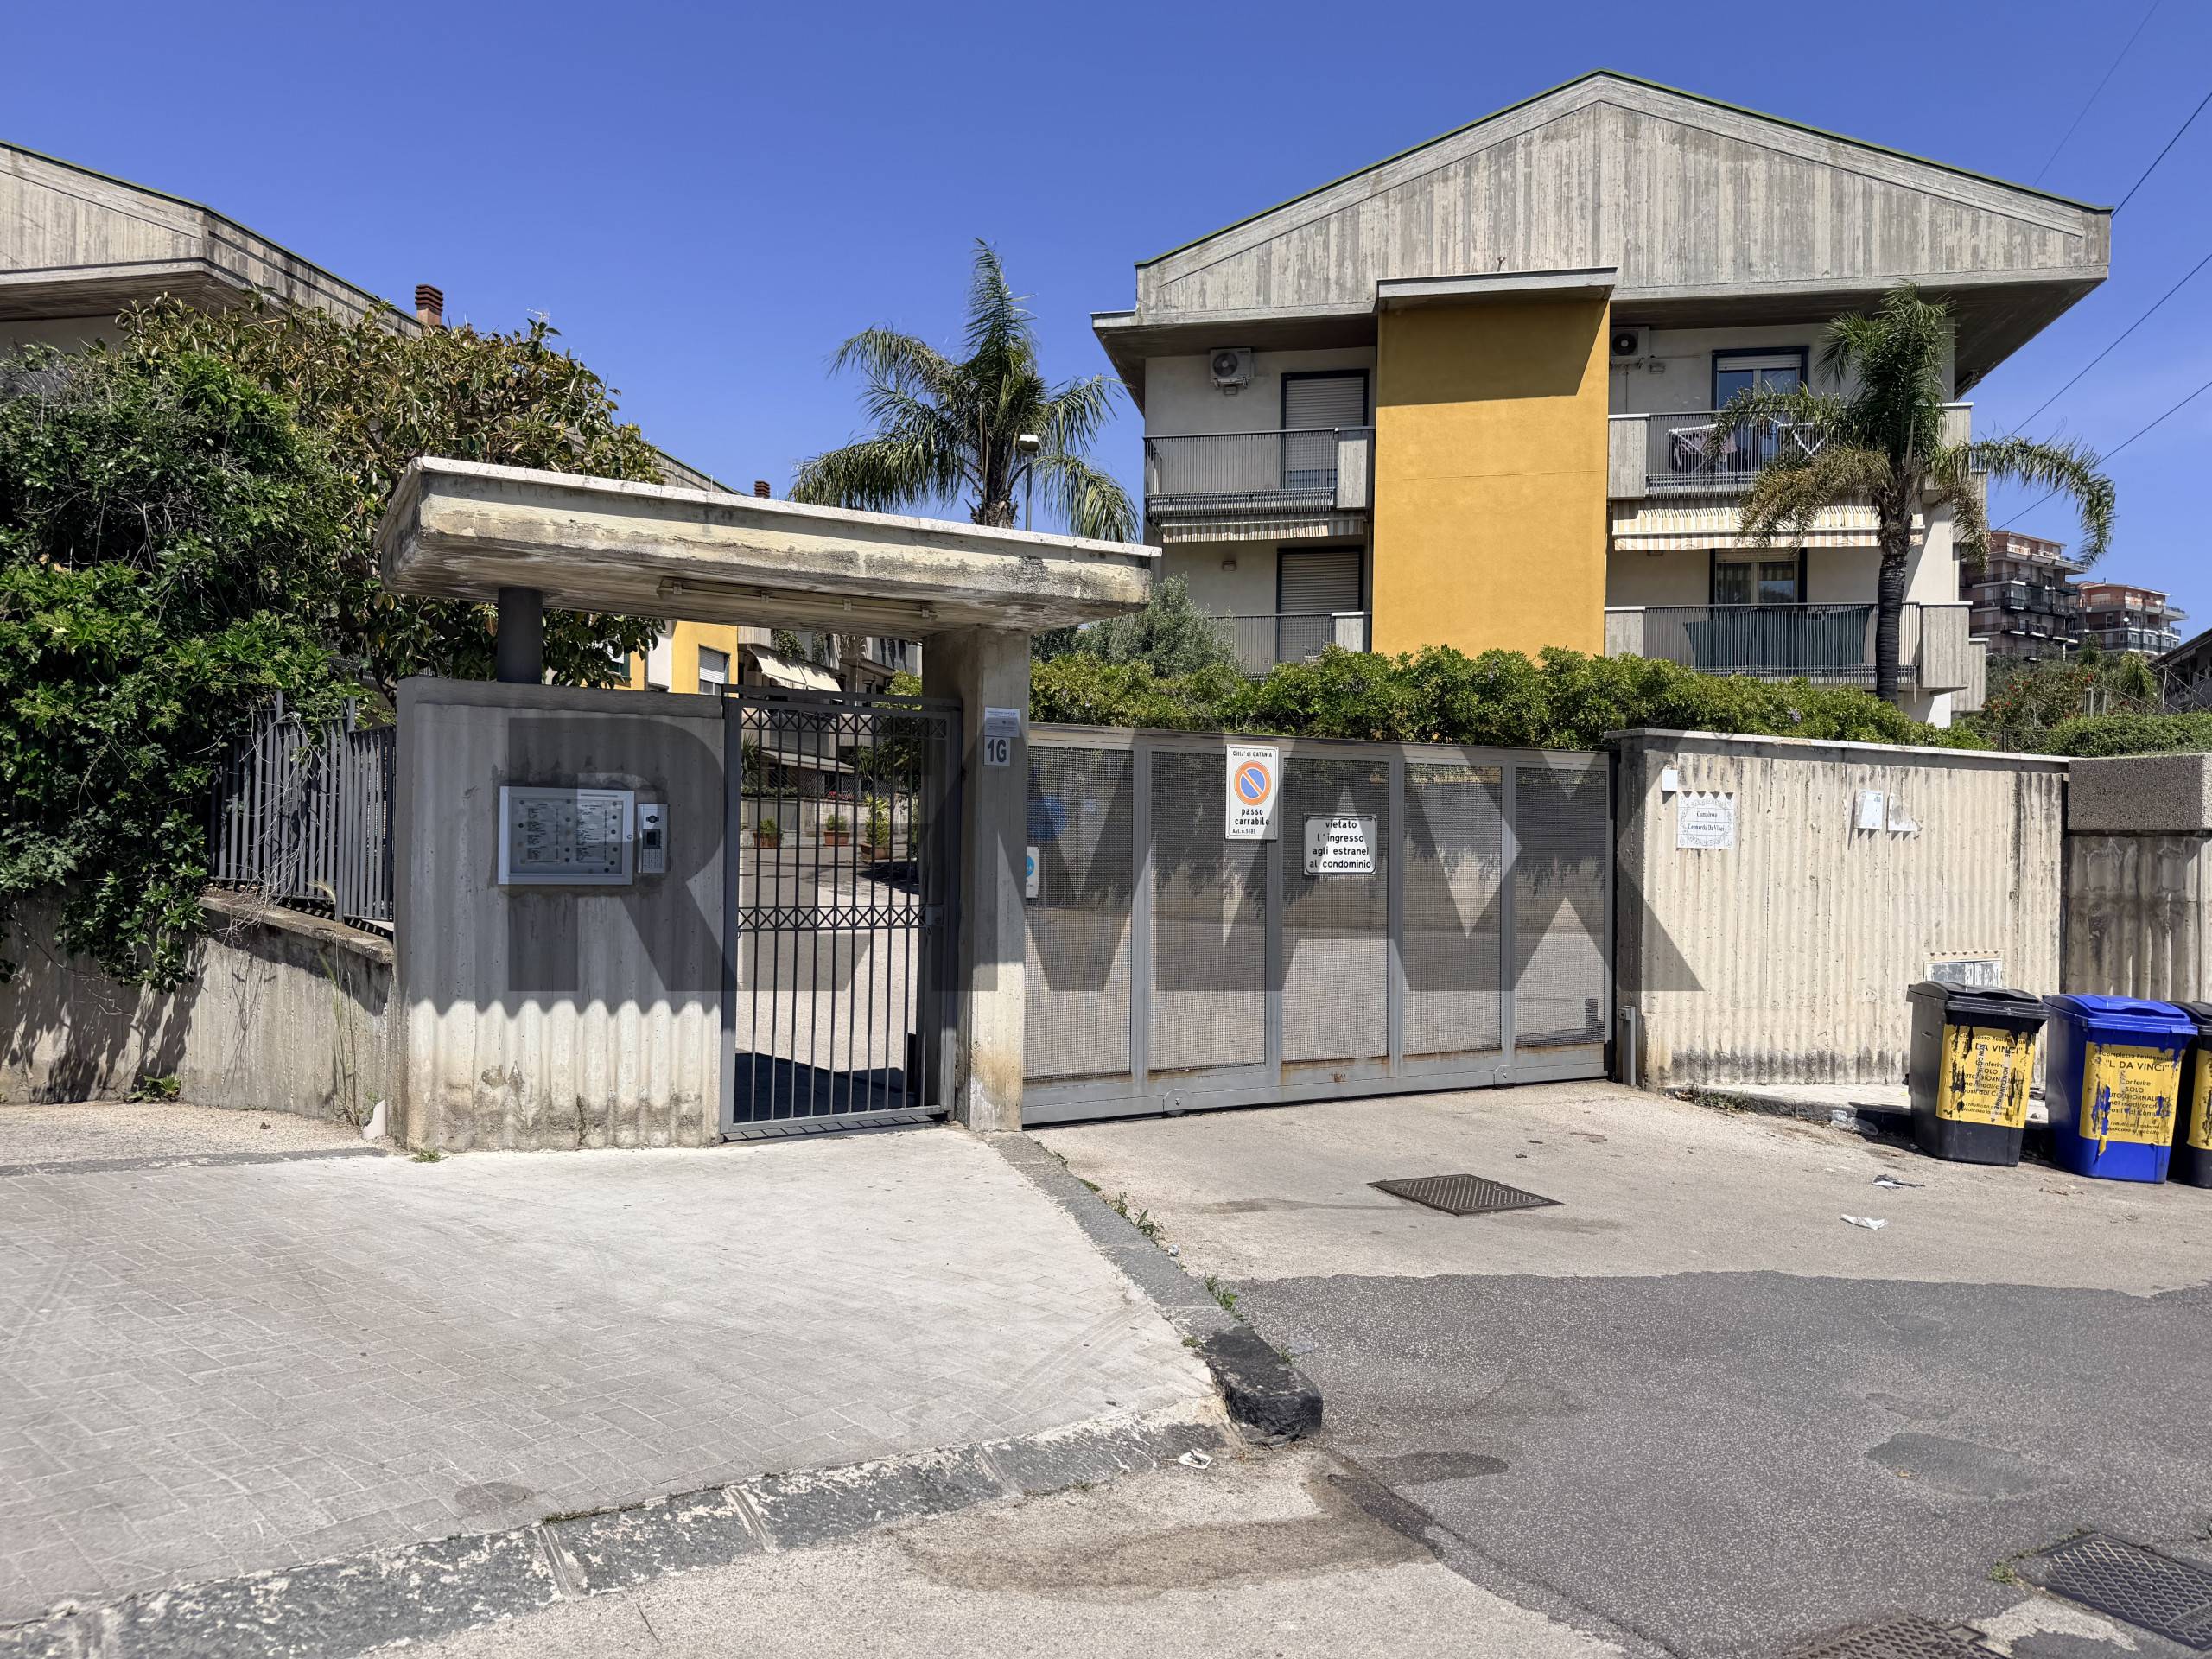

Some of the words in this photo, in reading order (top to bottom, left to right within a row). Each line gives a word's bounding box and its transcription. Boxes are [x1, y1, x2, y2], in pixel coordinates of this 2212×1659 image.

[1241, 808, 1263, 817] passo
[1235, 817, 1270, 826] carrabile
[1325, 819, 1357, 829] vietato
[1313, 846, 1329, 856] agli
[1332, 846, 1370, 855] estranei
[1309, 859, 1318, 868] al
[1322, 859, 1371, 868] condominio
